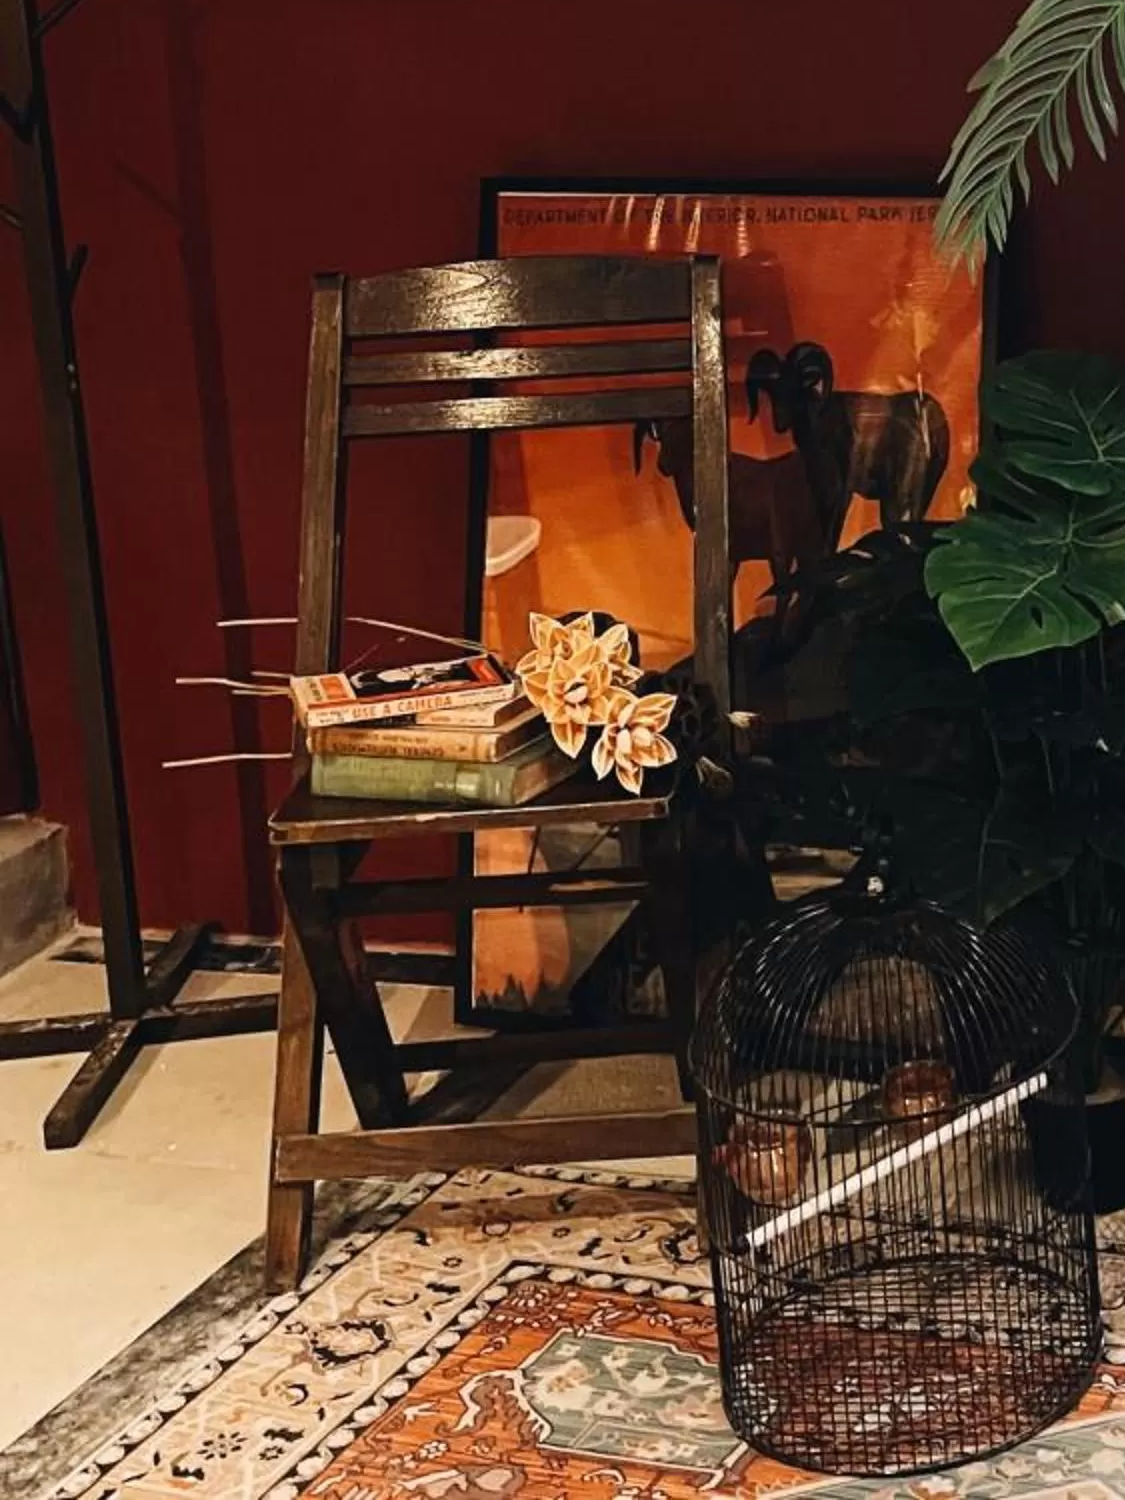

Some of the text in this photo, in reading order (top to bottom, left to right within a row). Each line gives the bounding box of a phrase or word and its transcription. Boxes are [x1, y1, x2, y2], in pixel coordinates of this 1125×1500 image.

[502, 207, 606, 225] DEPARTMENT
[766, 206, 849, 223] NATIONAL
[352, 705, 377, 719] USE
[383, 703, 392, 714] A
[397, 696, 453, 712] CAMERA
